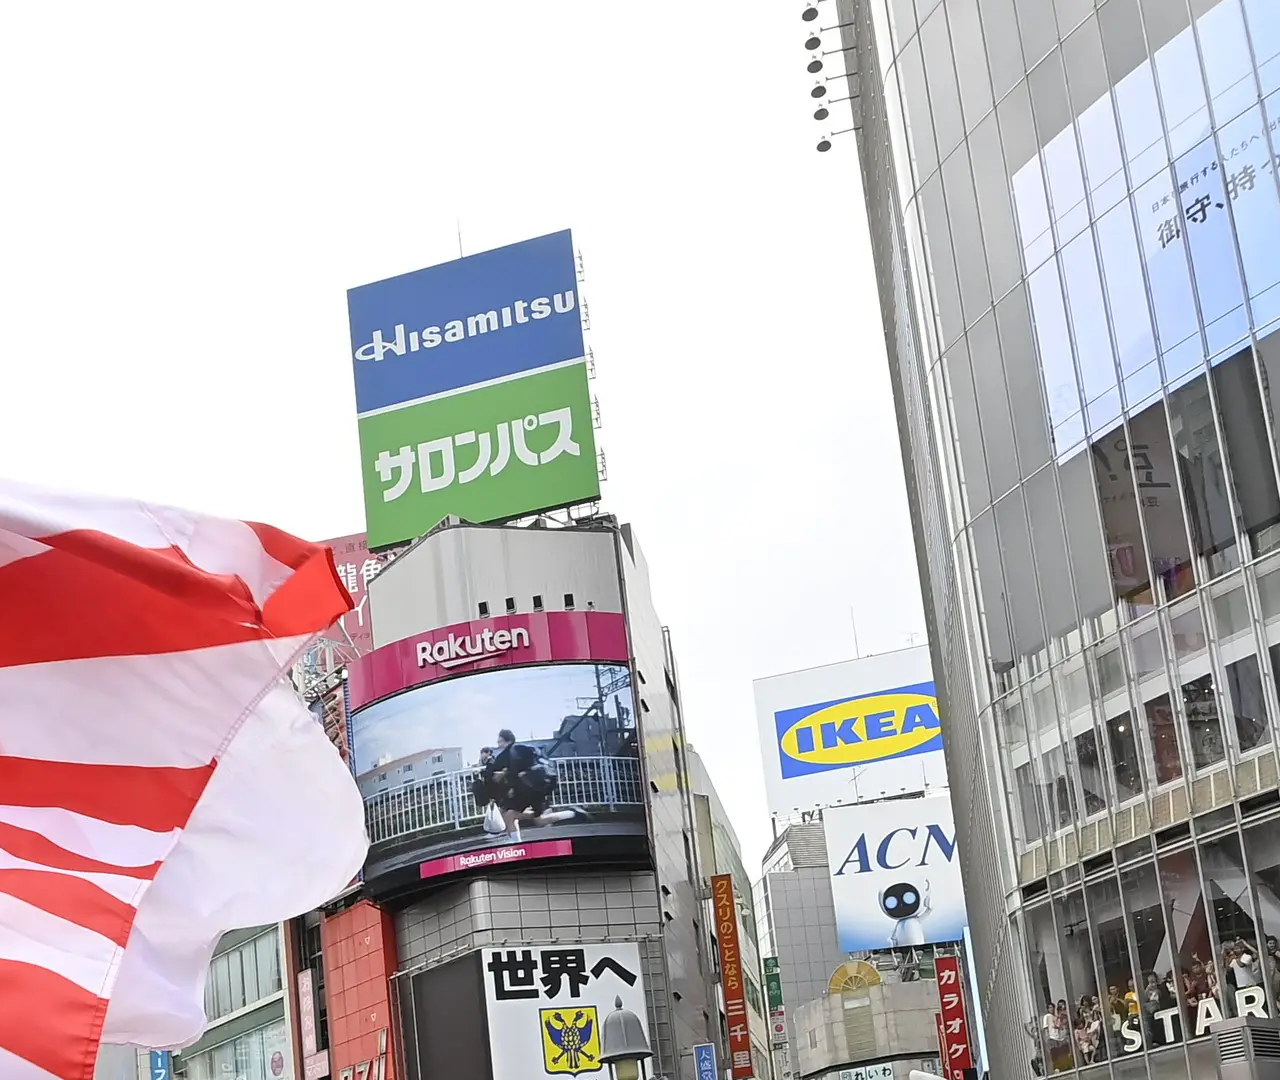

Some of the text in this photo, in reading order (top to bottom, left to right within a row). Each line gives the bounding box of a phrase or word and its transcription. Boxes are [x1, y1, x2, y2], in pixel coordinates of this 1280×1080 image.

[354, 289, 576, 362] Hisamitsu
[375, 406, 581, 503] サロンパス
[416, 625, 530, 667] Rakuten
[795, 703, 940, 754] IKEA
[460, 846, 526, 867] Rakuten Vision
[833, 824, 956, 877] ACN
[715, 879, 739, 991] クスリのことなら
[487, 949, 637, 1000] 世界へ
[726, 999, 752, 1069] 三千里
[939, 969, 967, 1060] カラオケ
